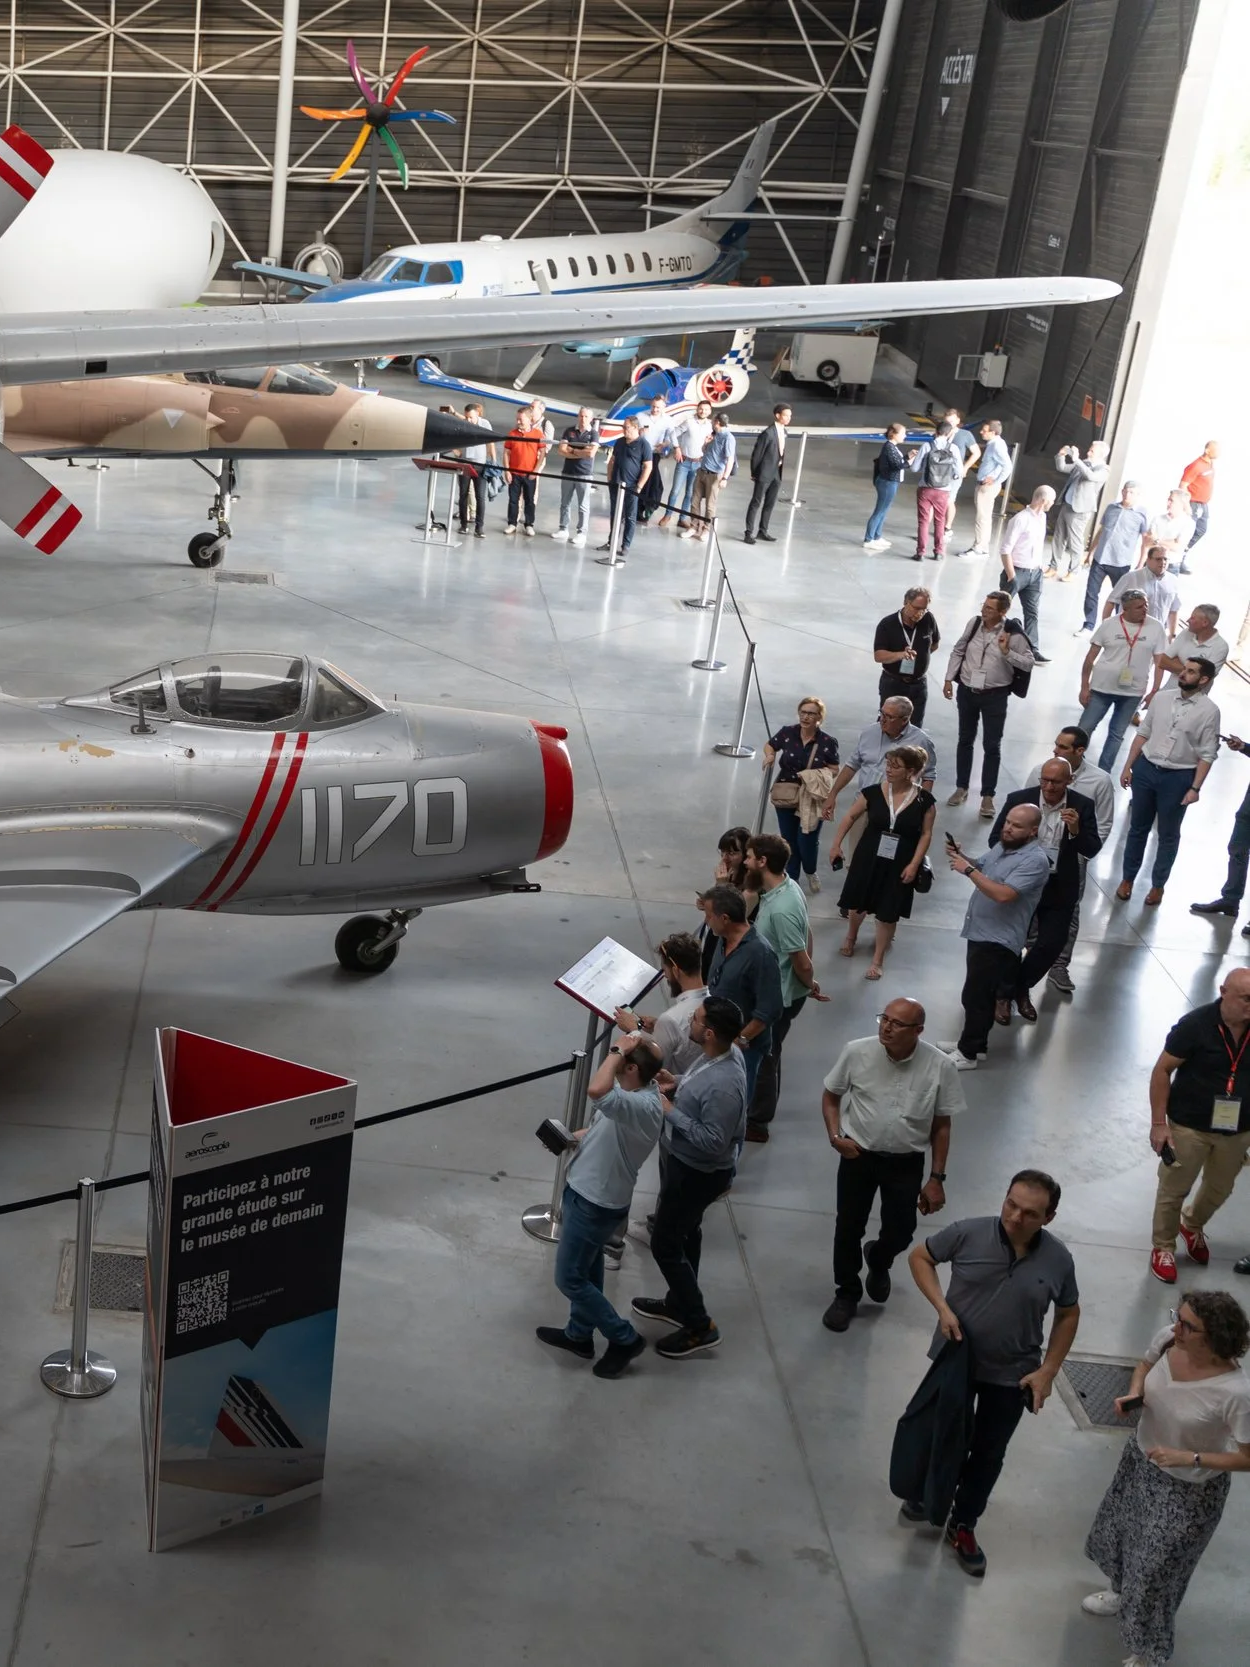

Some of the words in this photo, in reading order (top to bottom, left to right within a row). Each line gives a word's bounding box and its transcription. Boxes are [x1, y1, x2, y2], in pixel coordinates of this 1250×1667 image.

[299, 776, 468, 866] 1170
[185, 1141, 230, 1159] aeroscopia
[181, 1207, 233, 1234] grande
[237, 1195, 277, 1217] étude
[281, 1188, 305, 1205] sur
[183, 1181, 256, 1210] Participez
[260, 1175, 269, 1189] à
[274, 1166, 311, 1186] notre
[180, 1238, 194, 1253] le
[198, 1224, 246, 1248] musée
[250, 1219, 268, 1234] de
[272, 1203, 324, 1228] demain
